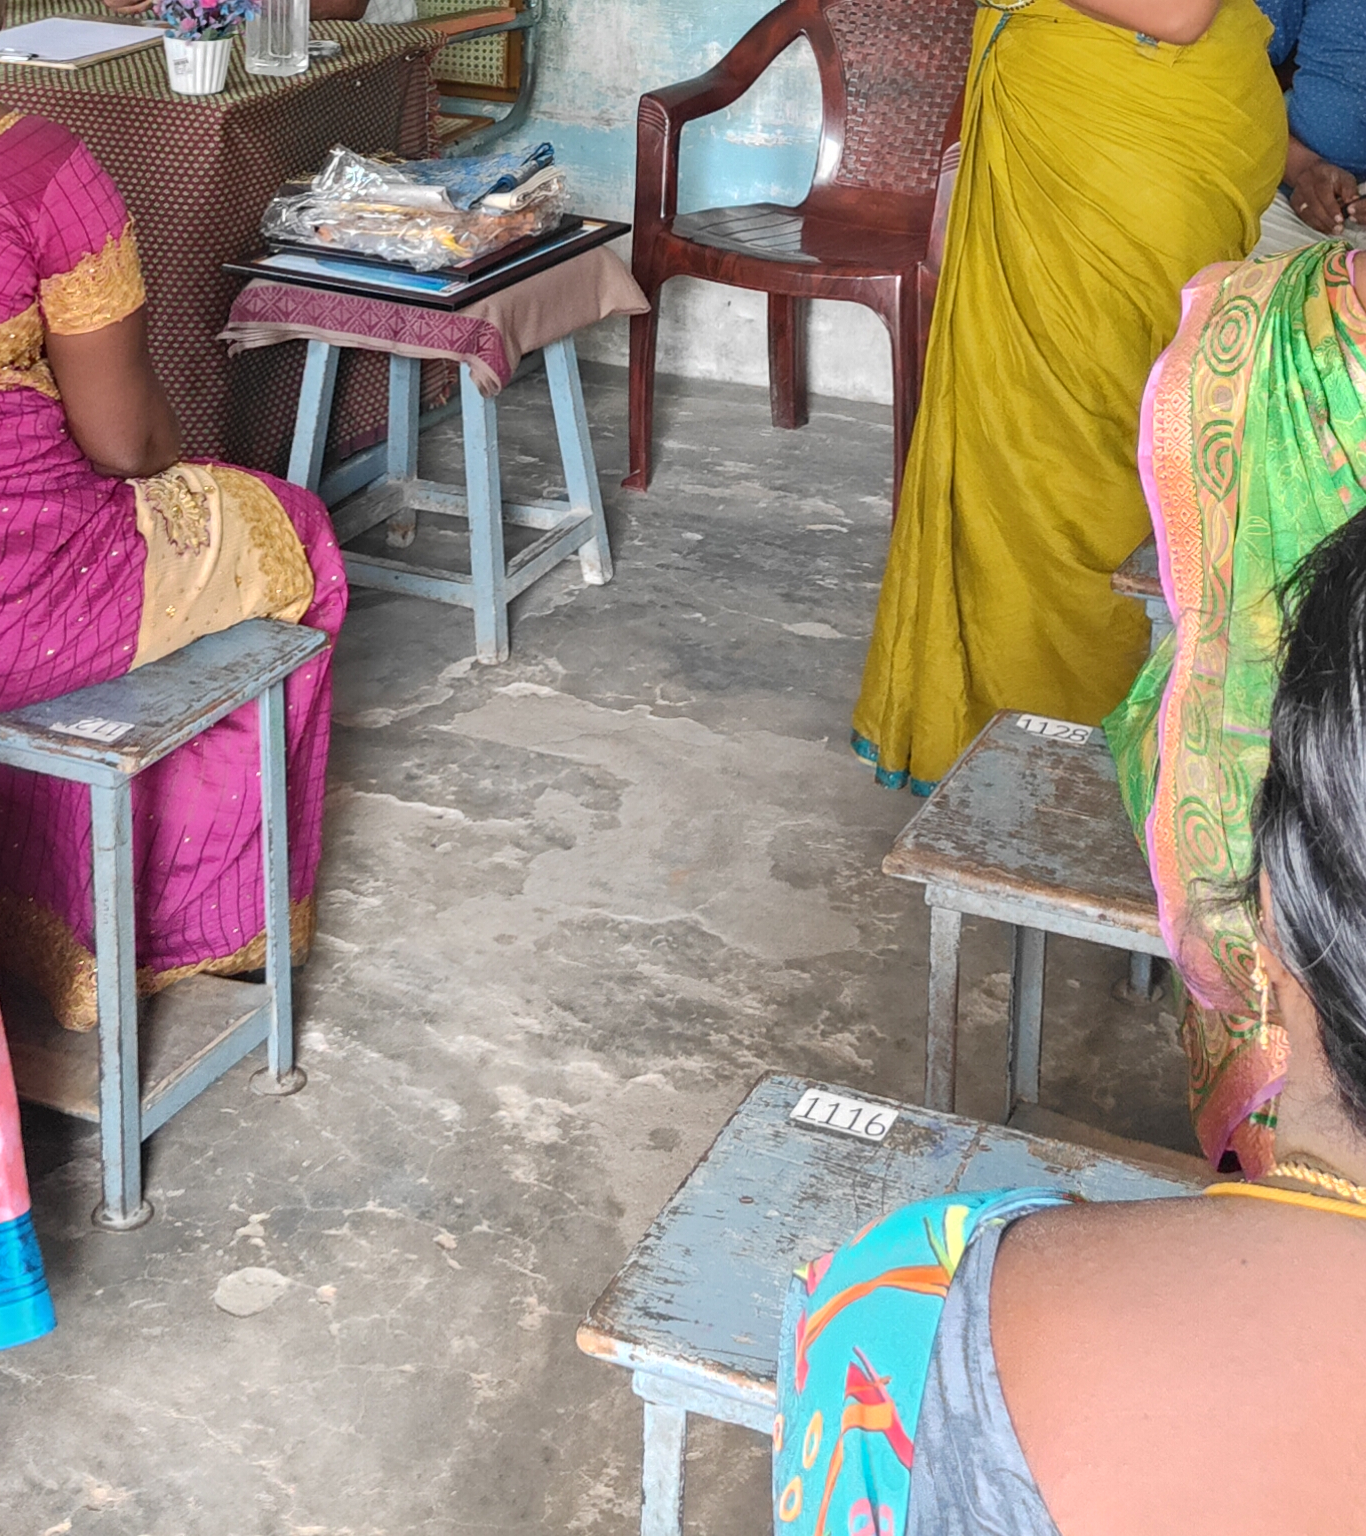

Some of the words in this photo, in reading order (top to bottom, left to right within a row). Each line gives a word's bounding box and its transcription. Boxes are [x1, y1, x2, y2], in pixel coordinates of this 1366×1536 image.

[65, 719, 125, 737] 112
[1021, 718, 1089, 742] 1128
[797, 1097, 886, 1136] 1116
